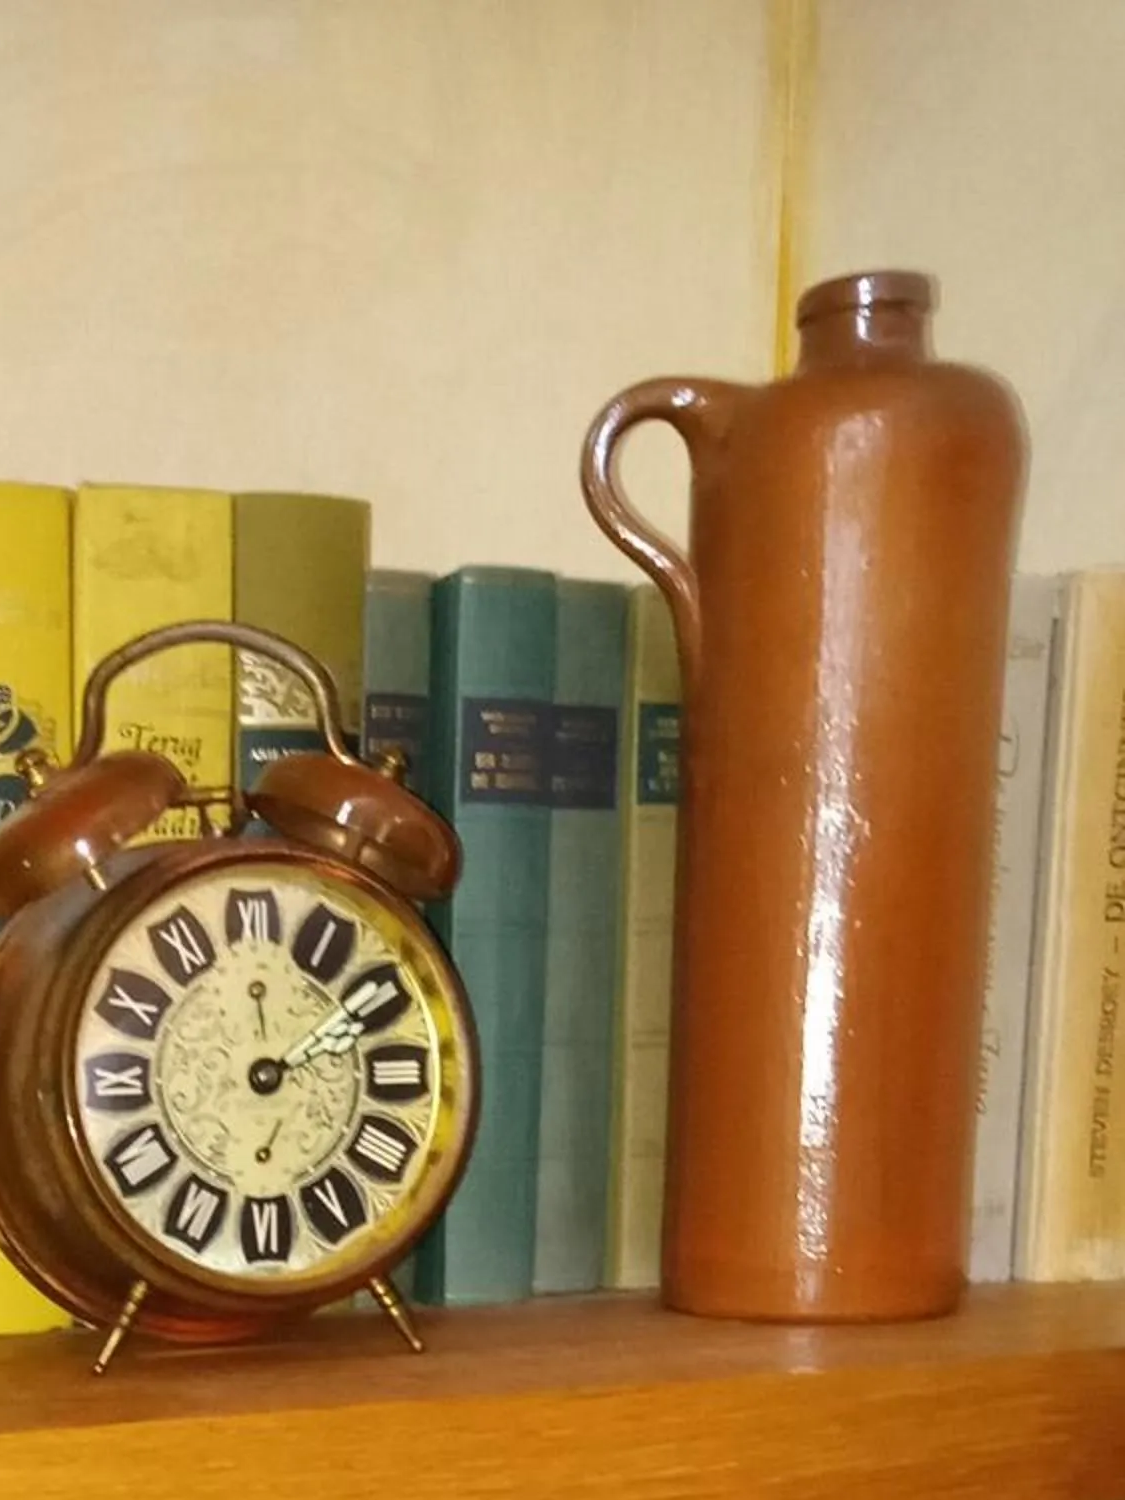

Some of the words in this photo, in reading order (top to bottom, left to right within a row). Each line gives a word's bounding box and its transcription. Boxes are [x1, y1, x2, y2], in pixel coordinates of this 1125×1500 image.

[119, 722, 204, 768] Terug
[236, 898, 269, 943] XII
[310, 920, 338, 969] I
[157, 916, 207, 975] XI
[107, 983, 159, 1027] X
[93, 1065, 144, 1097] IX
[372, 1059, 421, 1086] III
[354, 1123, 408, 1174] IIII
[1088, 1085, 1111, 1179] STEVEN
[314, 1177, 350, 1229] V
[249, 1203, 280, 1255] VI
